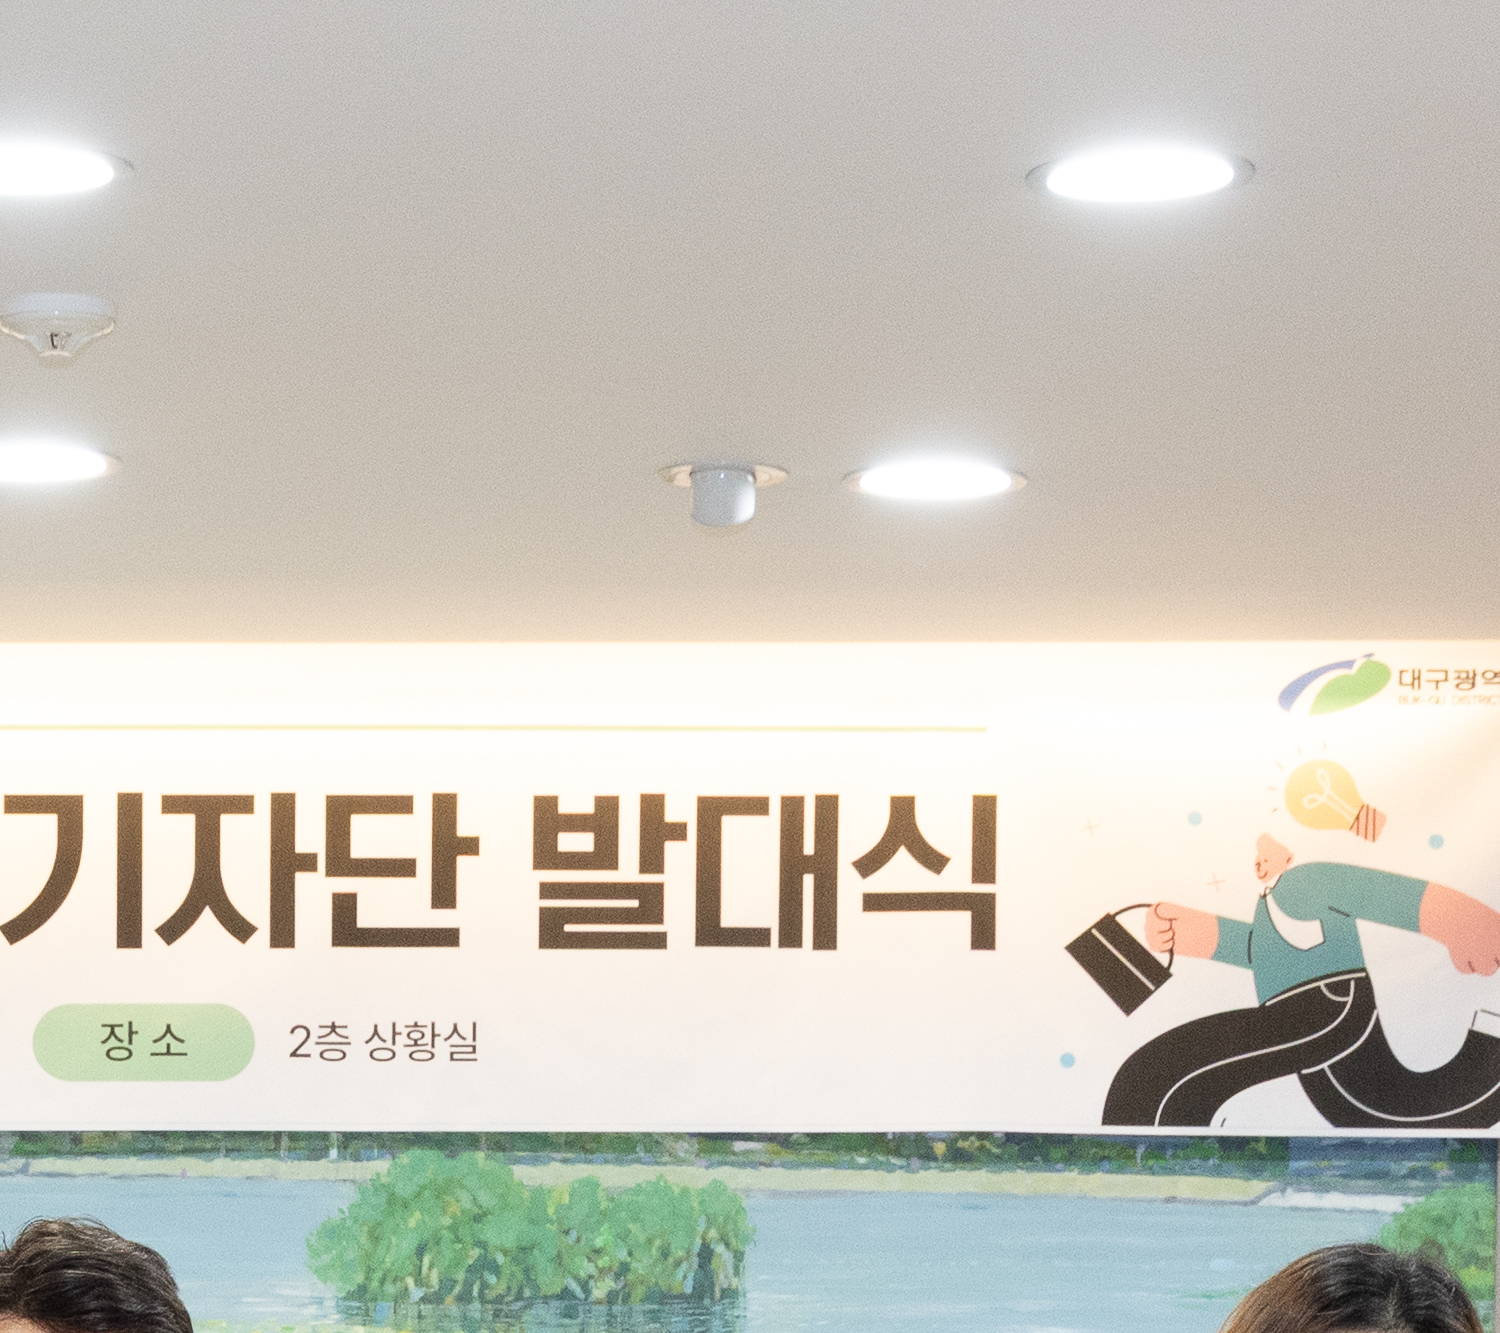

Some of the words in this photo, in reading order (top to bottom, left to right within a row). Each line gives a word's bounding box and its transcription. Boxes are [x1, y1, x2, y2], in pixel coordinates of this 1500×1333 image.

[531, 791, 997, 952] 발대식
[289, 1021, 352, 1062] 2층
[364, 1020, 479, 1062] 상황실
